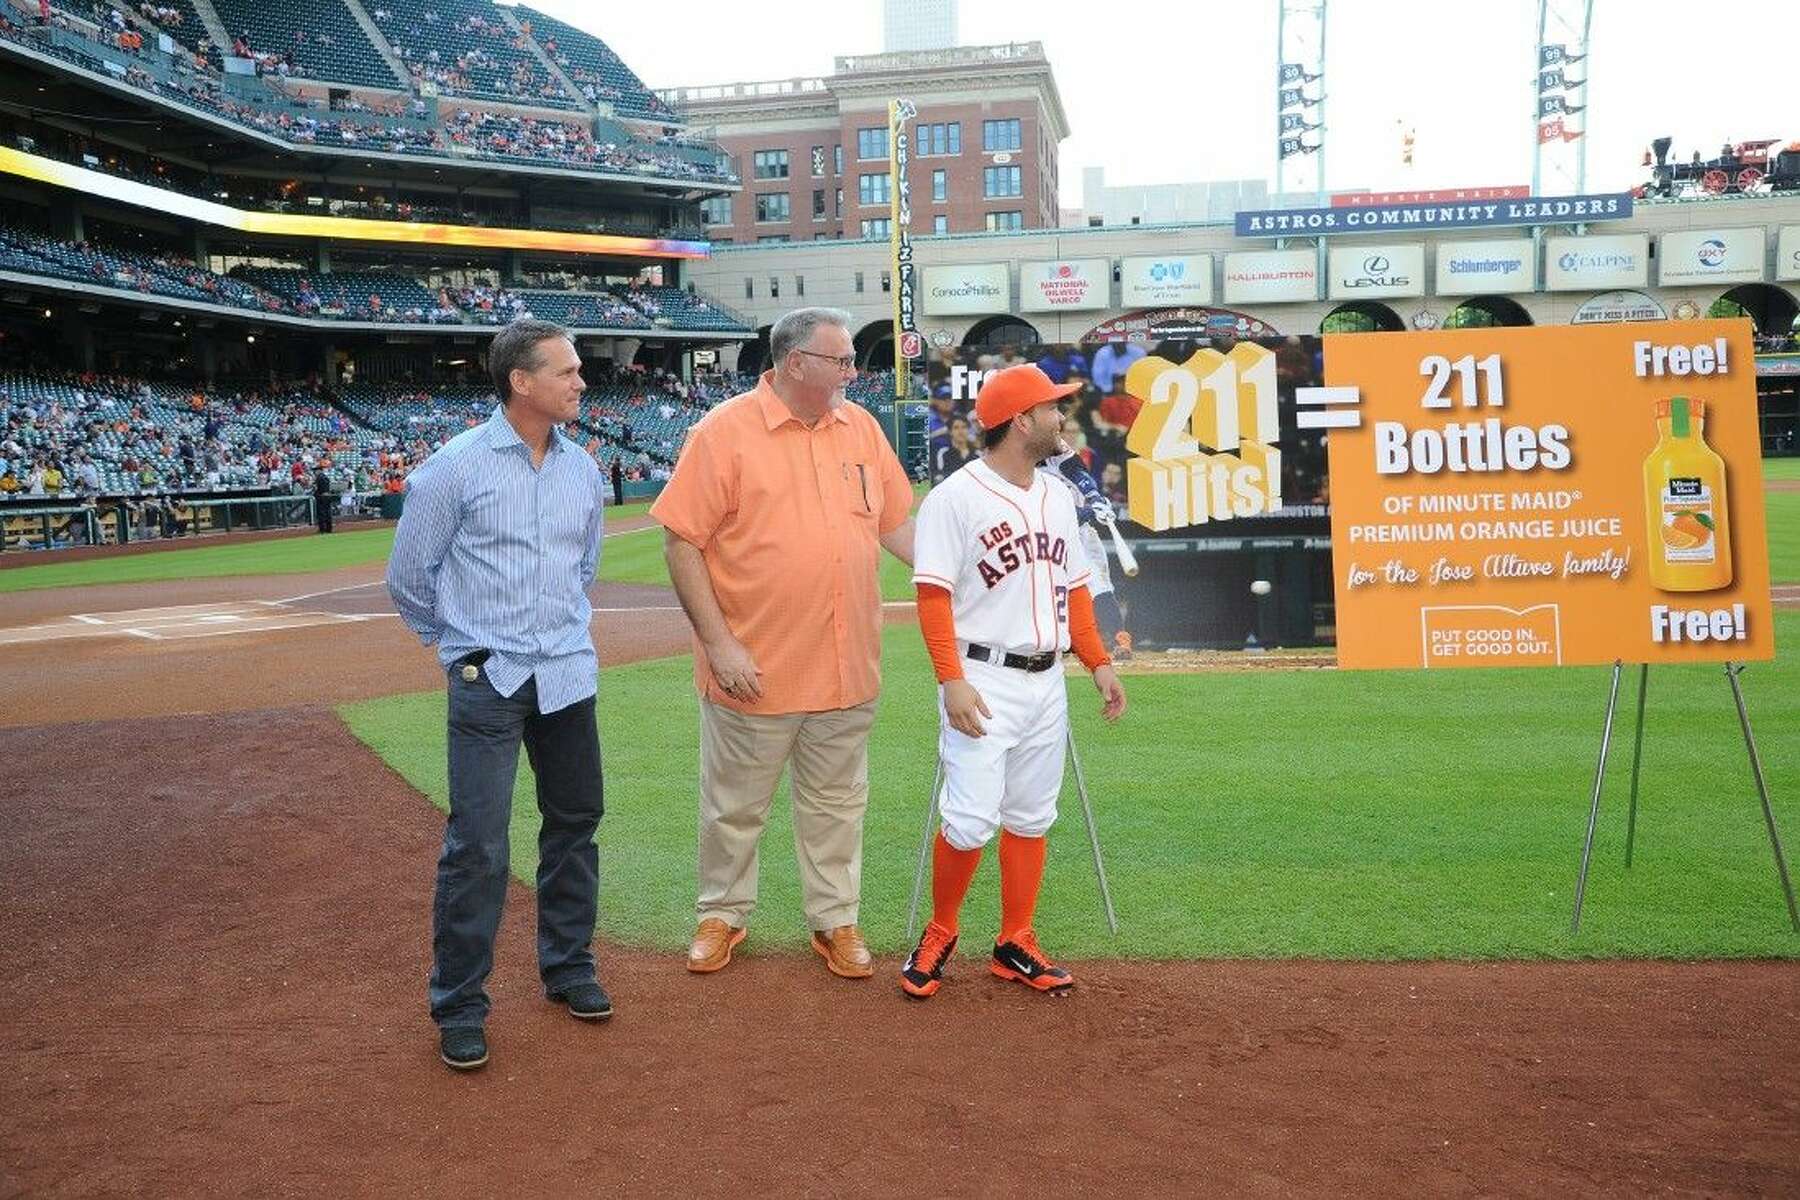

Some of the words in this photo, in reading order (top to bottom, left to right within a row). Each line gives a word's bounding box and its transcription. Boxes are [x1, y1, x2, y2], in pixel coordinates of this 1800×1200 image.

[1545, 75, 1559, 86] 01
[1284, 141, 1298, 152] 98
[1346, 205, 1498, 226] COMMUNITY
[1508, 199, 1619, 219] LEADERS
[1227, 271, 1314, 282] HALLIBURTON
[1449, 258, 1522, 275] Schlumberger
[932, 284, 1000, 298] ConocoPhillips
[1343, 276, 1410, 288] LEXUS
[901, 265, 915, 331] FARE
[1633, 337, 1728, 377] Free!
[951, 365, 993, 399] Fr
[1419, 353, 1504, 408] 211
[1126, 342, 1280, 462] 211
[1375, 417, 1571, 475] Bottles
[1128, 444, 1283, 532] Hits!
[1383, 495, 1413, 515] OF
[1419, 493, 1505, 514] MINUTE
[979, 521, 1013, 551] LOS
[1349, 523, 1455, 543] PREMIUM
[1460, 521, 1555, 540] ORANGE
[1559, 518, 1622, 538] JUICE
[976, 532, 1068, 590] ASTRO
[1347, 563, 1377, 589] for
[1377, 560, 1418, 584] the
[1429, 556, 1473, 585] Jose
[1483, 553, 1555, 578] Altuve
[1562, 547, 1632, 580] family!
[1431, 629, 1462, 643] PUT
[1465, 629, 1513, 642] GOOD
[1516, 627, 1537, 641] IN.
[1650, 603, 1746, 642] Free!
[1432, 643, 1462, 656] GET
[1465, 642, 1513, 656] GOOD
[1517, 641, 1553, 655] OUT.
